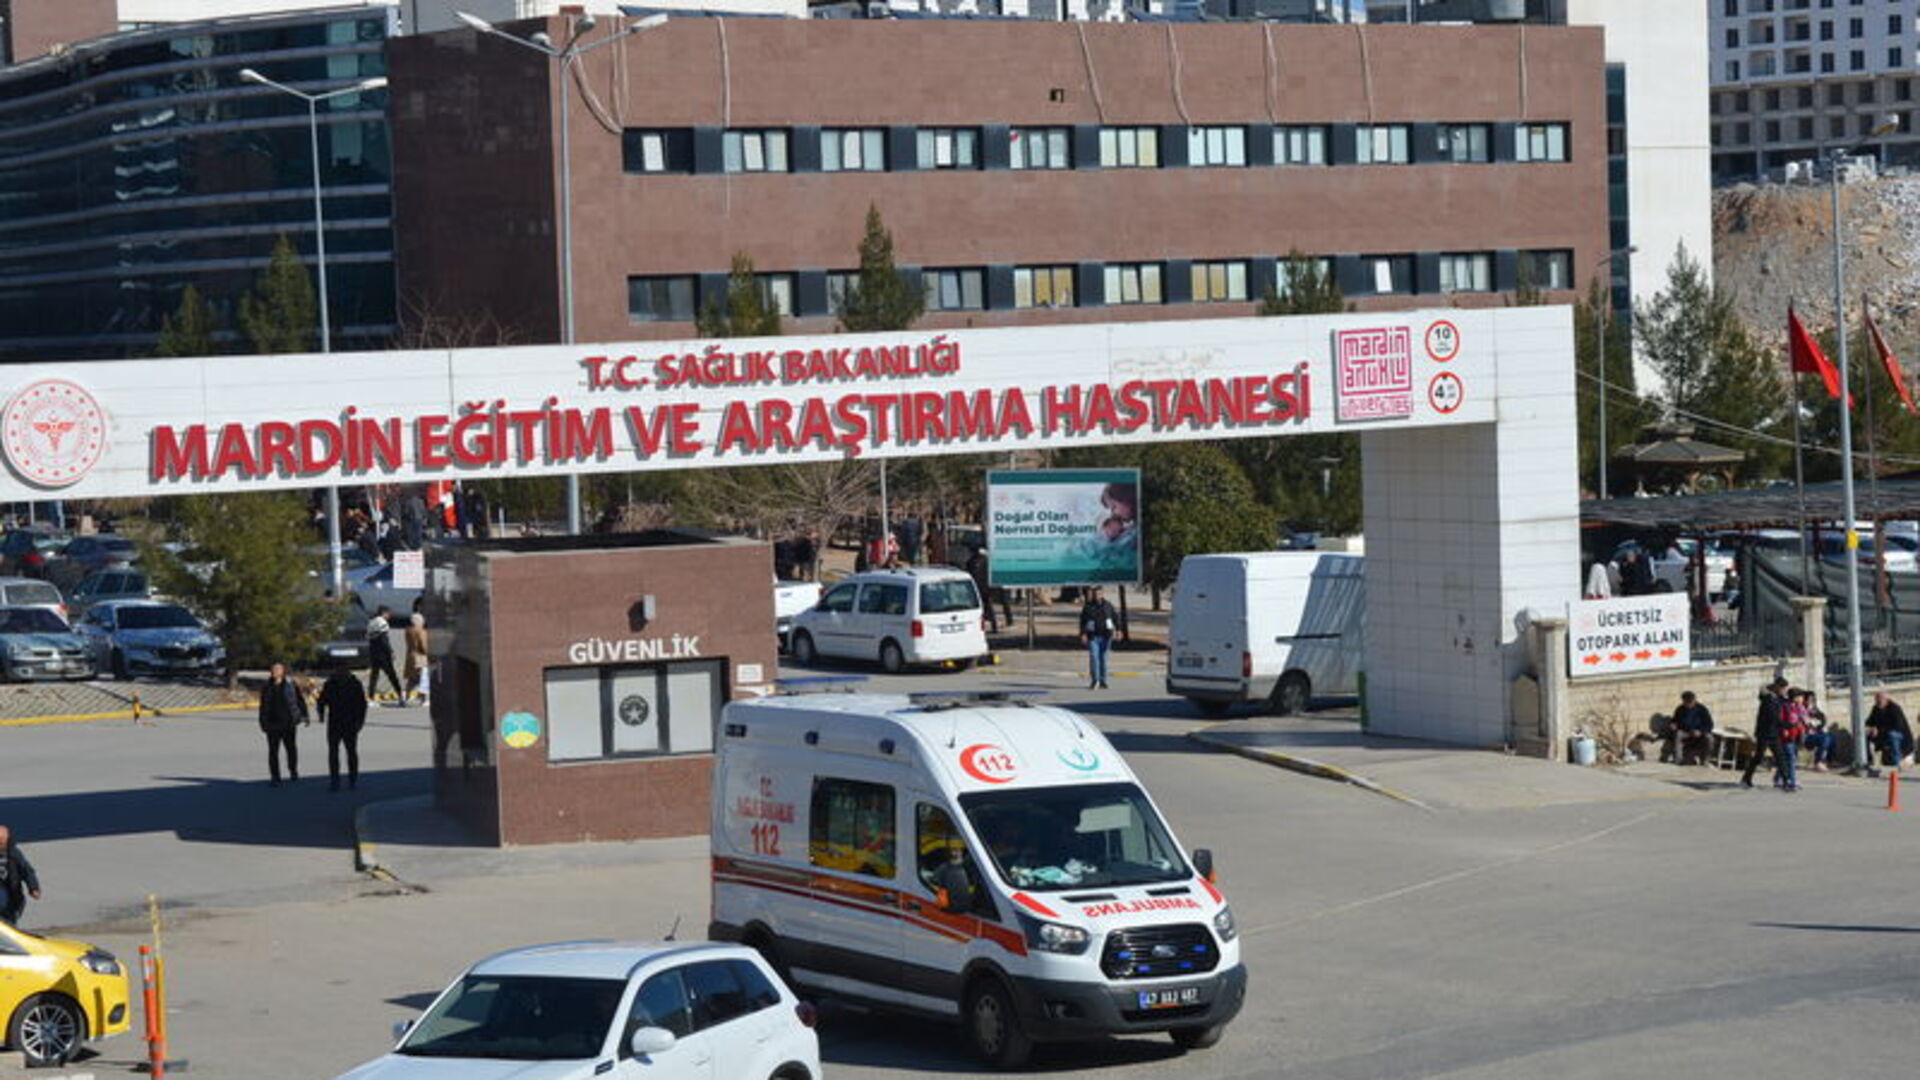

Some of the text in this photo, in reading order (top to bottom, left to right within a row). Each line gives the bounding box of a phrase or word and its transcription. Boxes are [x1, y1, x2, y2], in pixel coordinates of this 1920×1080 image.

[1434, 325, 1452, 340] 10
[583, 335, 960, 388] T.C. SAĞLIK BAKANLIĞI
[152, 405, 403, 481] MARDİN
[416, 396, 614, 470] EĞİTİM
[627, 402, 702, 455] VE
[718, 384, 1034, 459] ARAŞTIRMA
[1045, 361, 1311, 434] HASTANESİ
[994, 511, 1069, 524] Doğal Olan
[994, 524, 1097, 537] Normal Doğum
[1597, 607, 1662, 627] ÜCRETSİZ
[569, 632, 700, 663] GÜVENLİK
[1577, 629, 1683, 651] OTOPARK ALANI
[979, 754, 1015, 771] 112
[750, 822, 780, 857] 112
